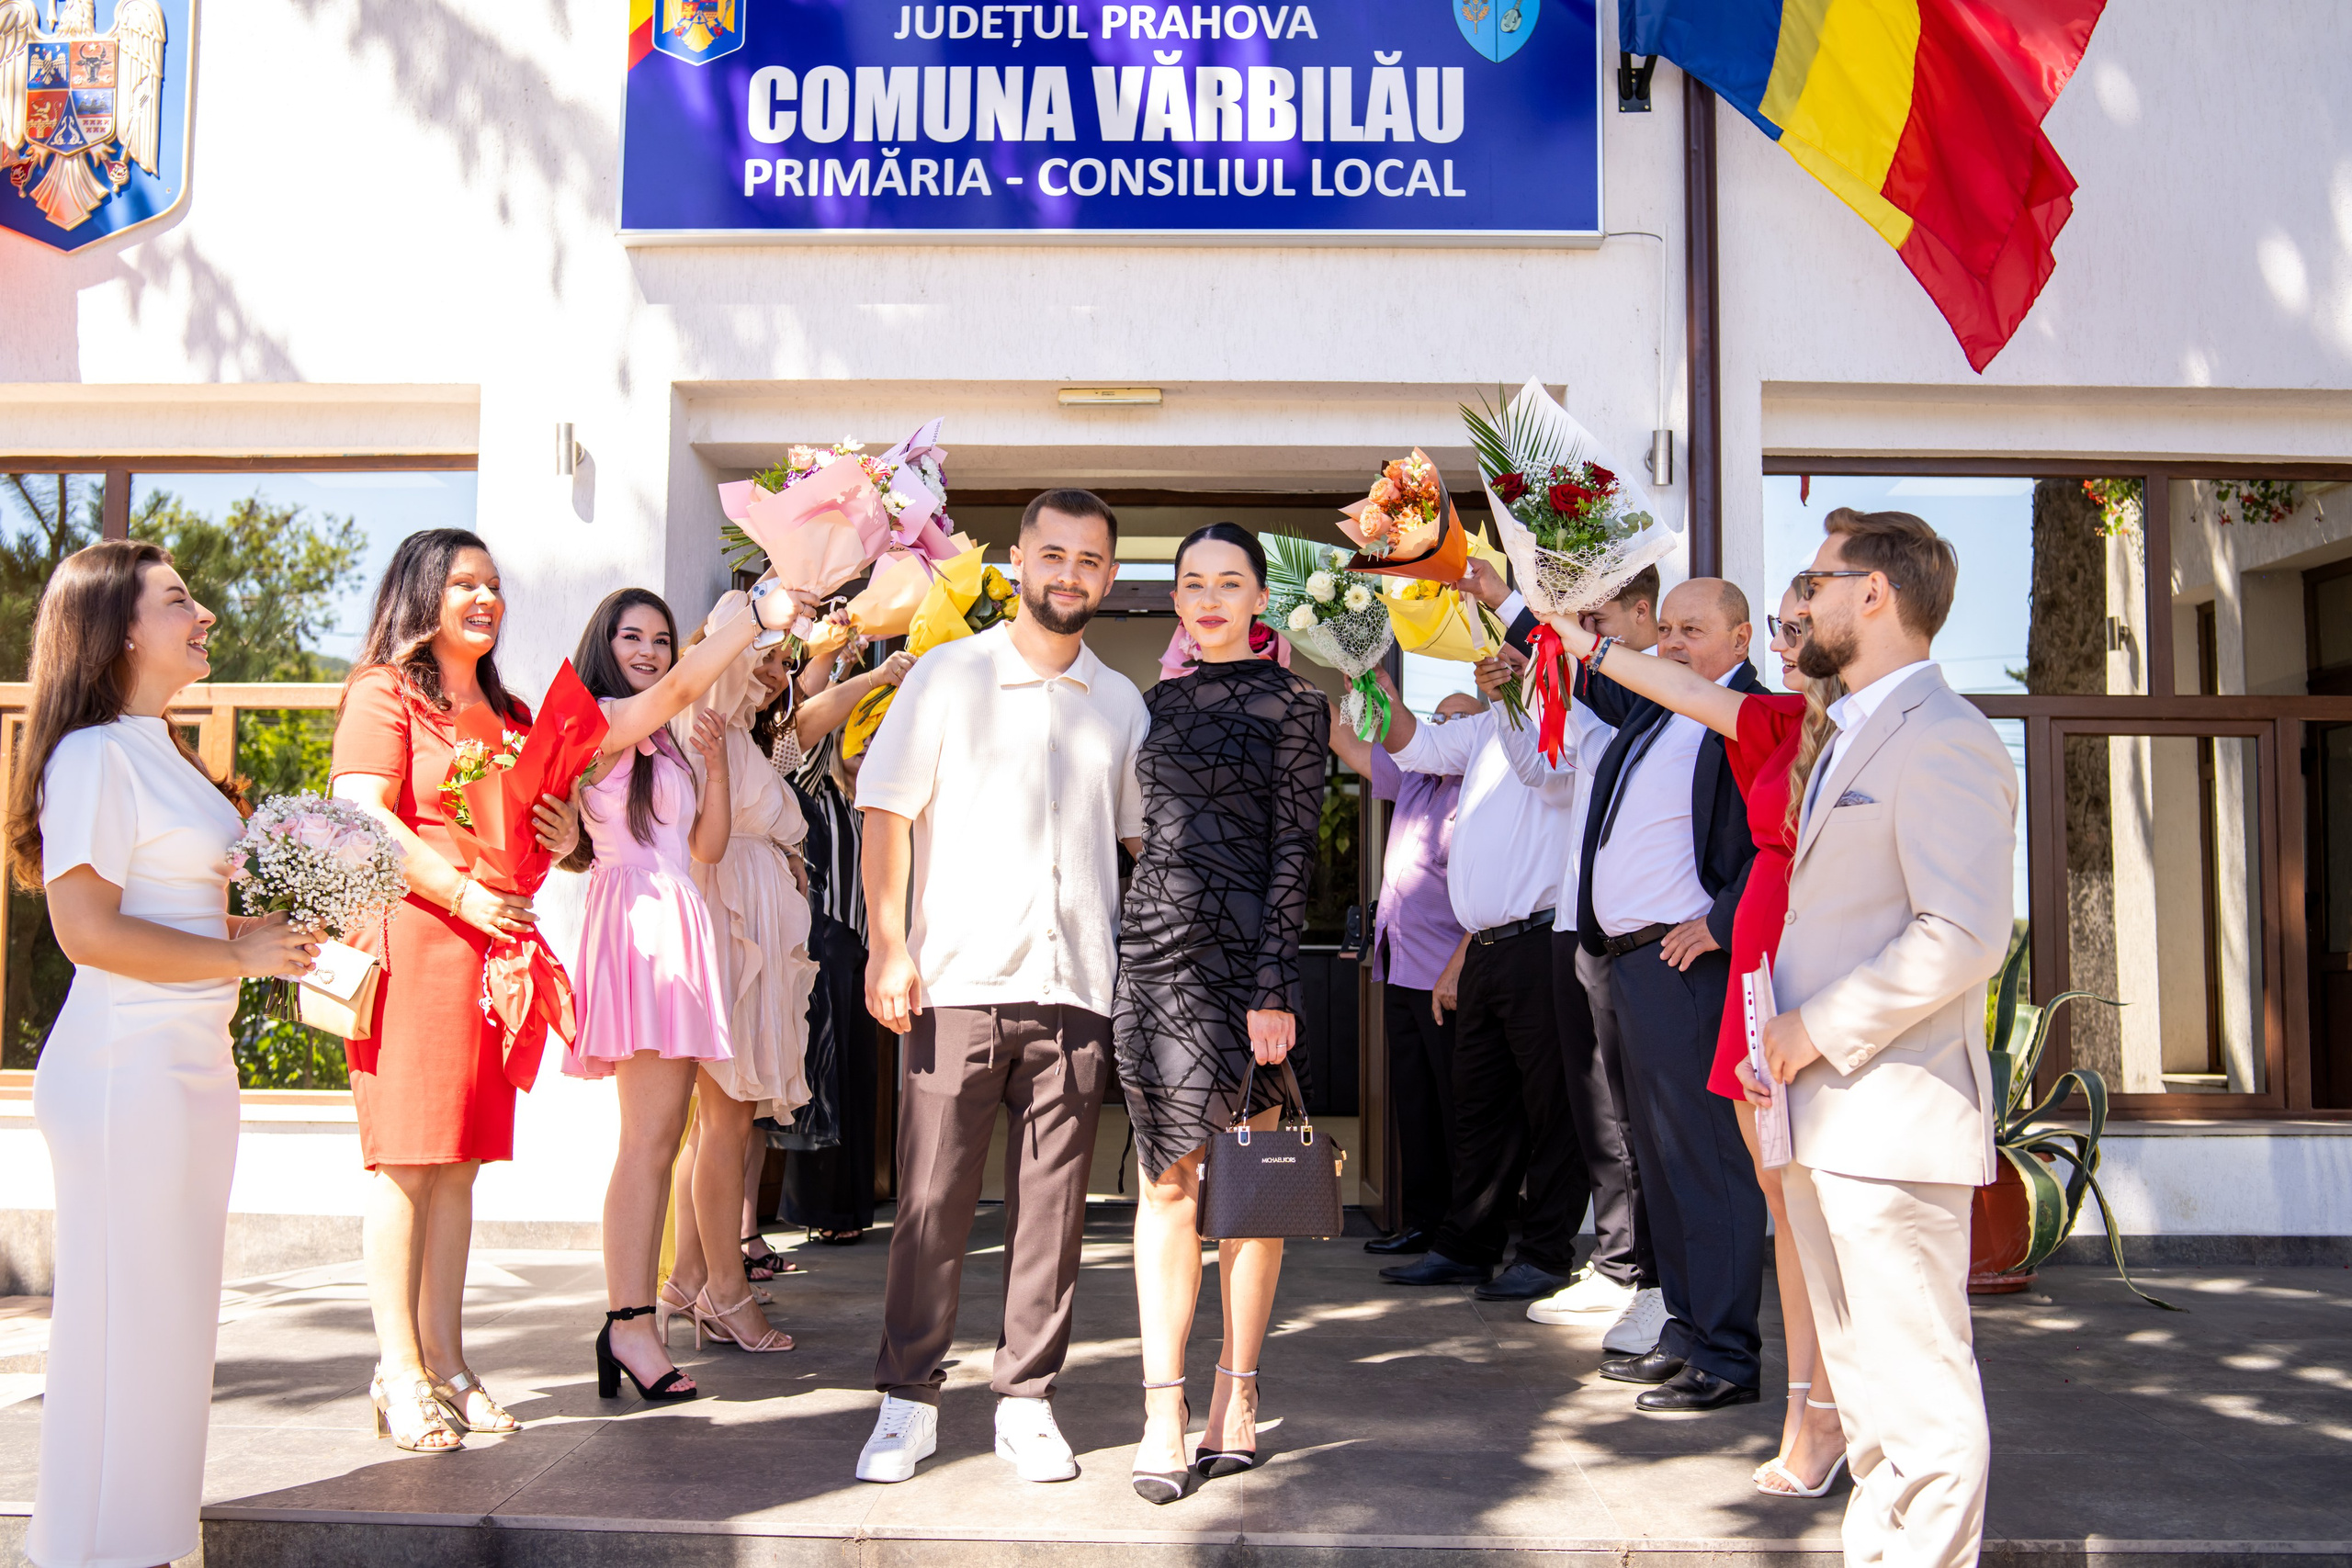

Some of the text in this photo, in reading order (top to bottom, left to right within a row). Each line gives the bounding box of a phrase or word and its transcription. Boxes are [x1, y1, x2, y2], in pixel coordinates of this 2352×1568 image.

[893, 5, 1318, 49] JUDEȚUL PRAHOVA
[747, 49, 1464, 144] COMUNA VĂRBILĂU
[744, 147, 992, 197] PRIMĂRIA
[1037, 157, 1296, 197] CONSILIUL
[1312, 158, 1466, 197] LOCAL
